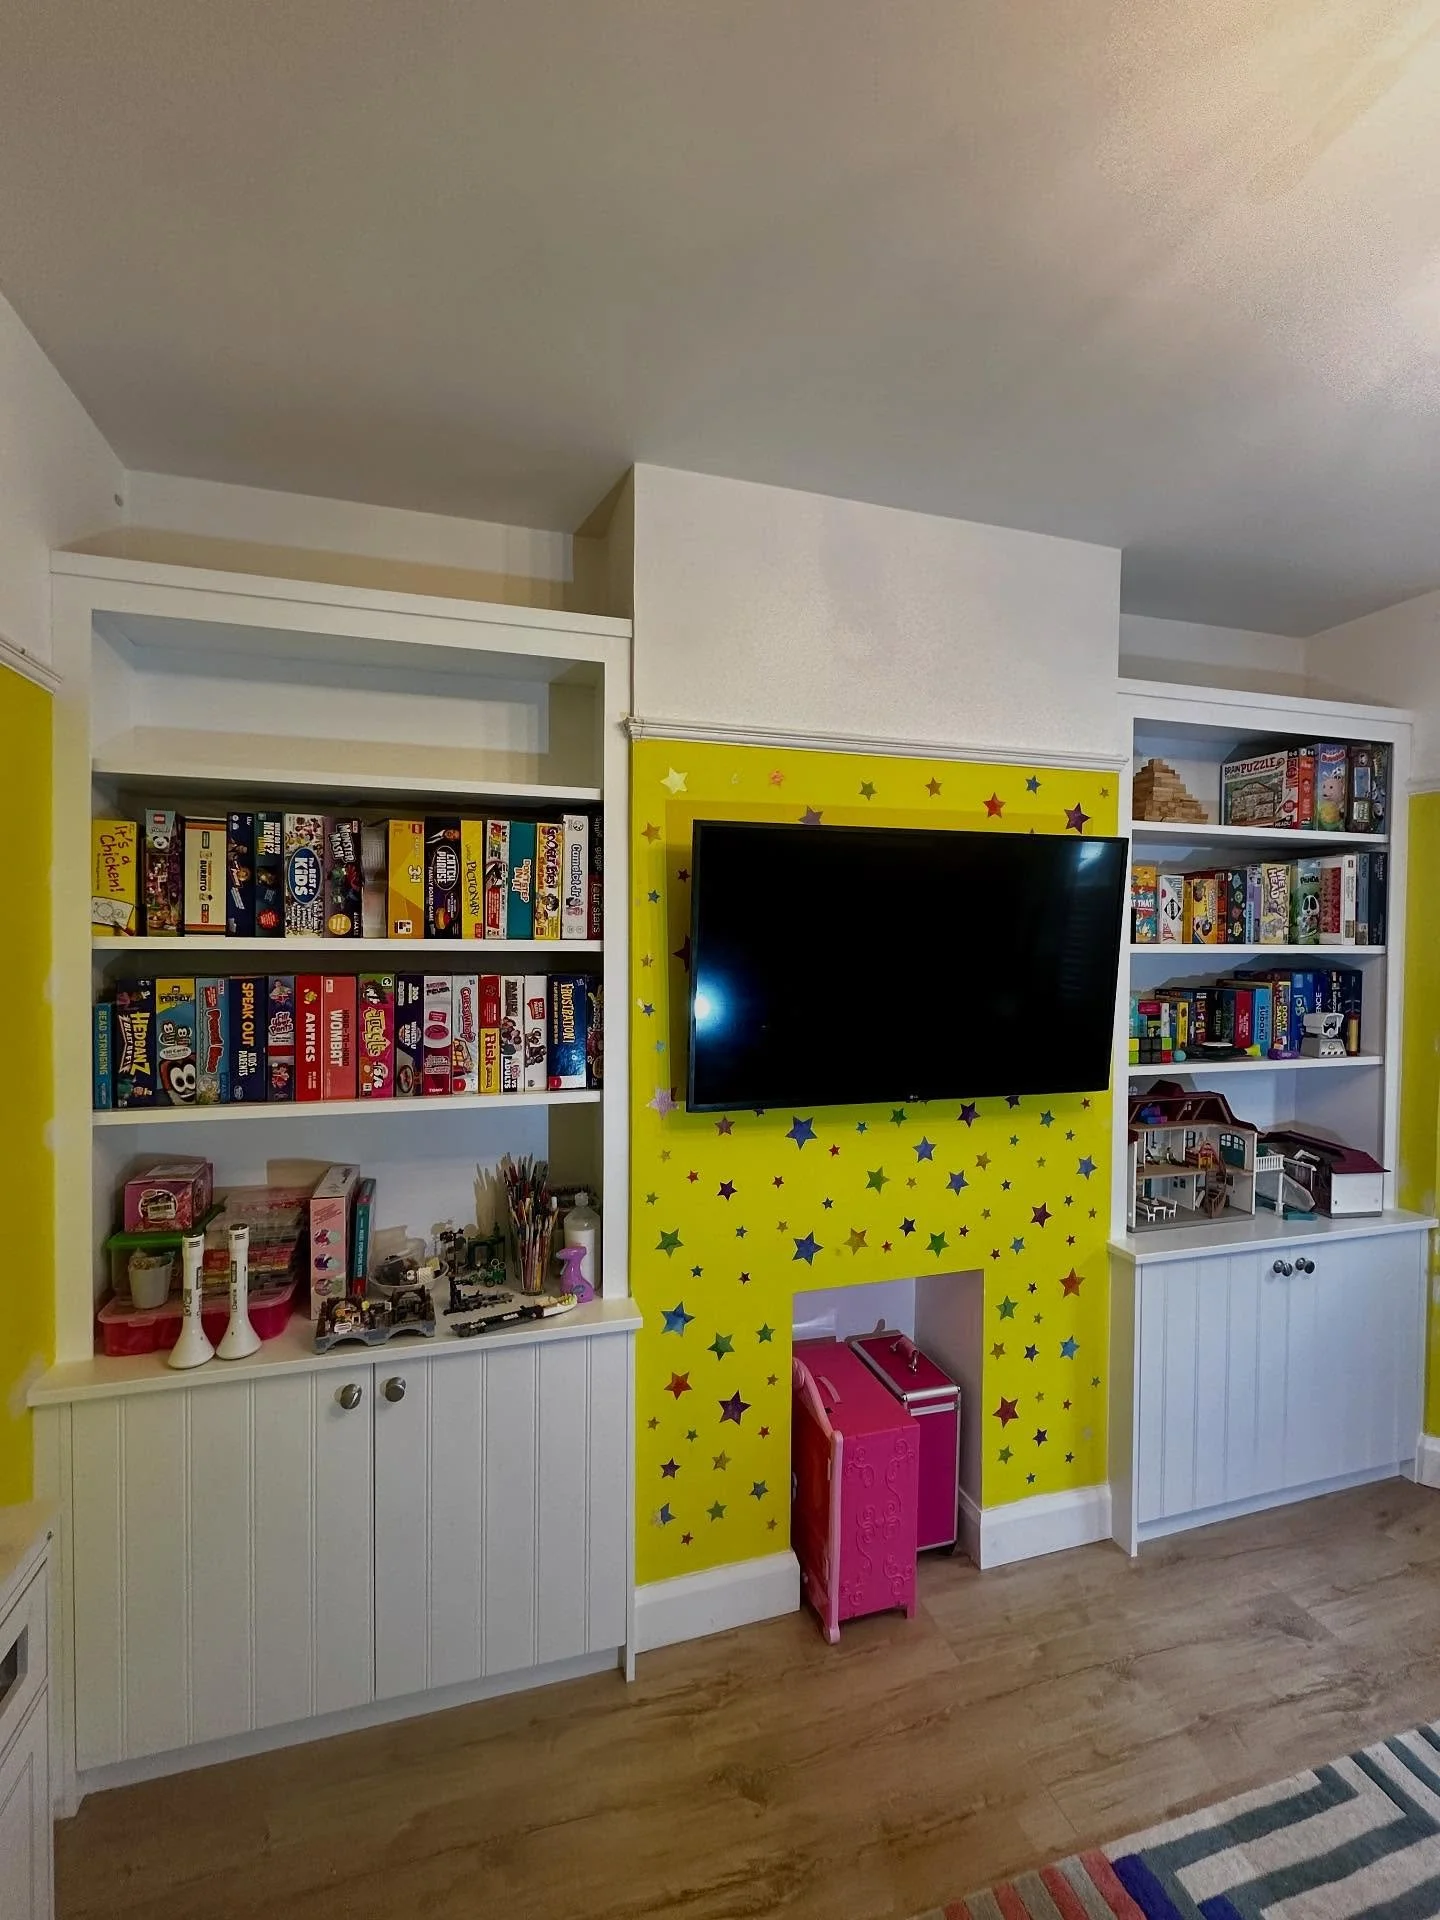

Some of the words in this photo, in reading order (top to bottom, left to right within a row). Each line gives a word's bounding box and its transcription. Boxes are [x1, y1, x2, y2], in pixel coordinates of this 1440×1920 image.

[1240, 757, 1276, 773] PUZZLE
[114, 825, 133, 849] It's
[263, 821, 275, 854] MEME?
[330, 833, 344, 858] MASH
[341, 823, 355, 862] MONSTER
[545, 826, 559, 864] GOOGLY
[99, 834, 125, 893] Chicken!
[121, 855, 131, 865] a
[436, 850, 447, 884] PHRASE
[446, 853, 457, 881] CATCH
[515, 867, 523, 878] IN
[523, 860, 531, 882] DON'T
[570, 844, 582, 885] Camelot
[199, 859, 207, 892] BURRITO
[294, 857, 309, 896] KiDS
[308, 868, 317, 887] BEST
[466, 861, 480, 917] PICTIONARY
[1267, 867, 1278, 900] HEAD
[1276, 867, 1288, 895] WET
[1300, 876, 1319, 884] PANDA
[521, 882, 529, 902] STEP
[570, 886, 581, 898] Jr
[591, 883, 602, 906] four
[593, 906, 602, 933] stars
[242, 982, 254, 1020] SPEAK
[461, 988, 473, 1014] Guess
[98, 1010, 107, 1031] BEAD
[270, 1023, 293, 1034] Pants
[277, 1012, 289, 1021] Fill
[461, 1013, 476, 1042] Who?
[122, 1021, 133, 1044] BLAST
[130, 1011, 151, 1076] HEDBANZ
[242, 1021, 254, 1047] OUT
[305, 1012, 316, 1062] ANTICS
[330, 1009, 343, 1067] WOMBAT
[98, 1033, 108, 1075] STRINGING
[248, 1052, 257, 1067] KIDS
[485, 1033, 497, 1066] Risk
[238, 1050, 248, 1077] PARENTS
[504, 1058, 512, 1089] ADULTS
[511, 1078, 518, 1089] VS
